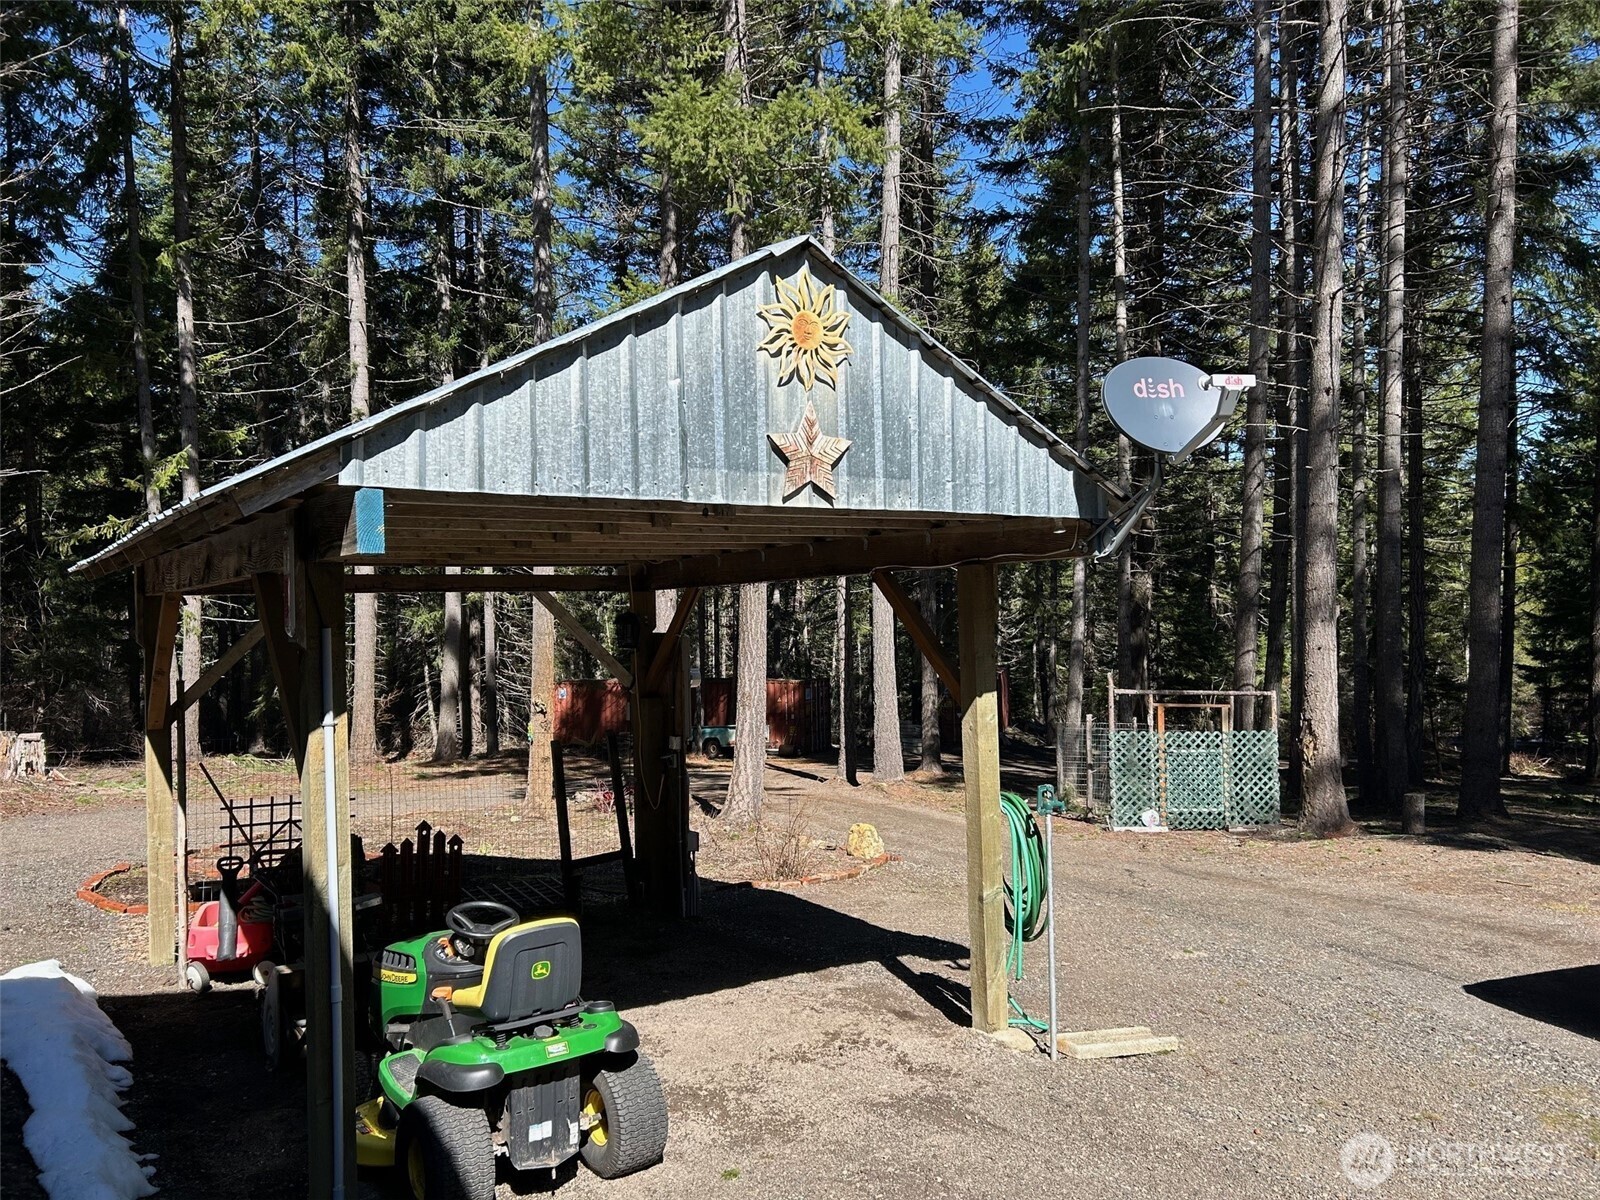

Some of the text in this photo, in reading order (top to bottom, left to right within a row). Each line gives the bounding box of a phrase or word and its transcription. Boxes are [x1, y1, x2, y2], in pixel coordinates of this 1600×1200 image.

[1225, 376, 1243, 386] dish
[1133, 378, 1185, 398] dish
[391, 973, 408, 982] DEERE
